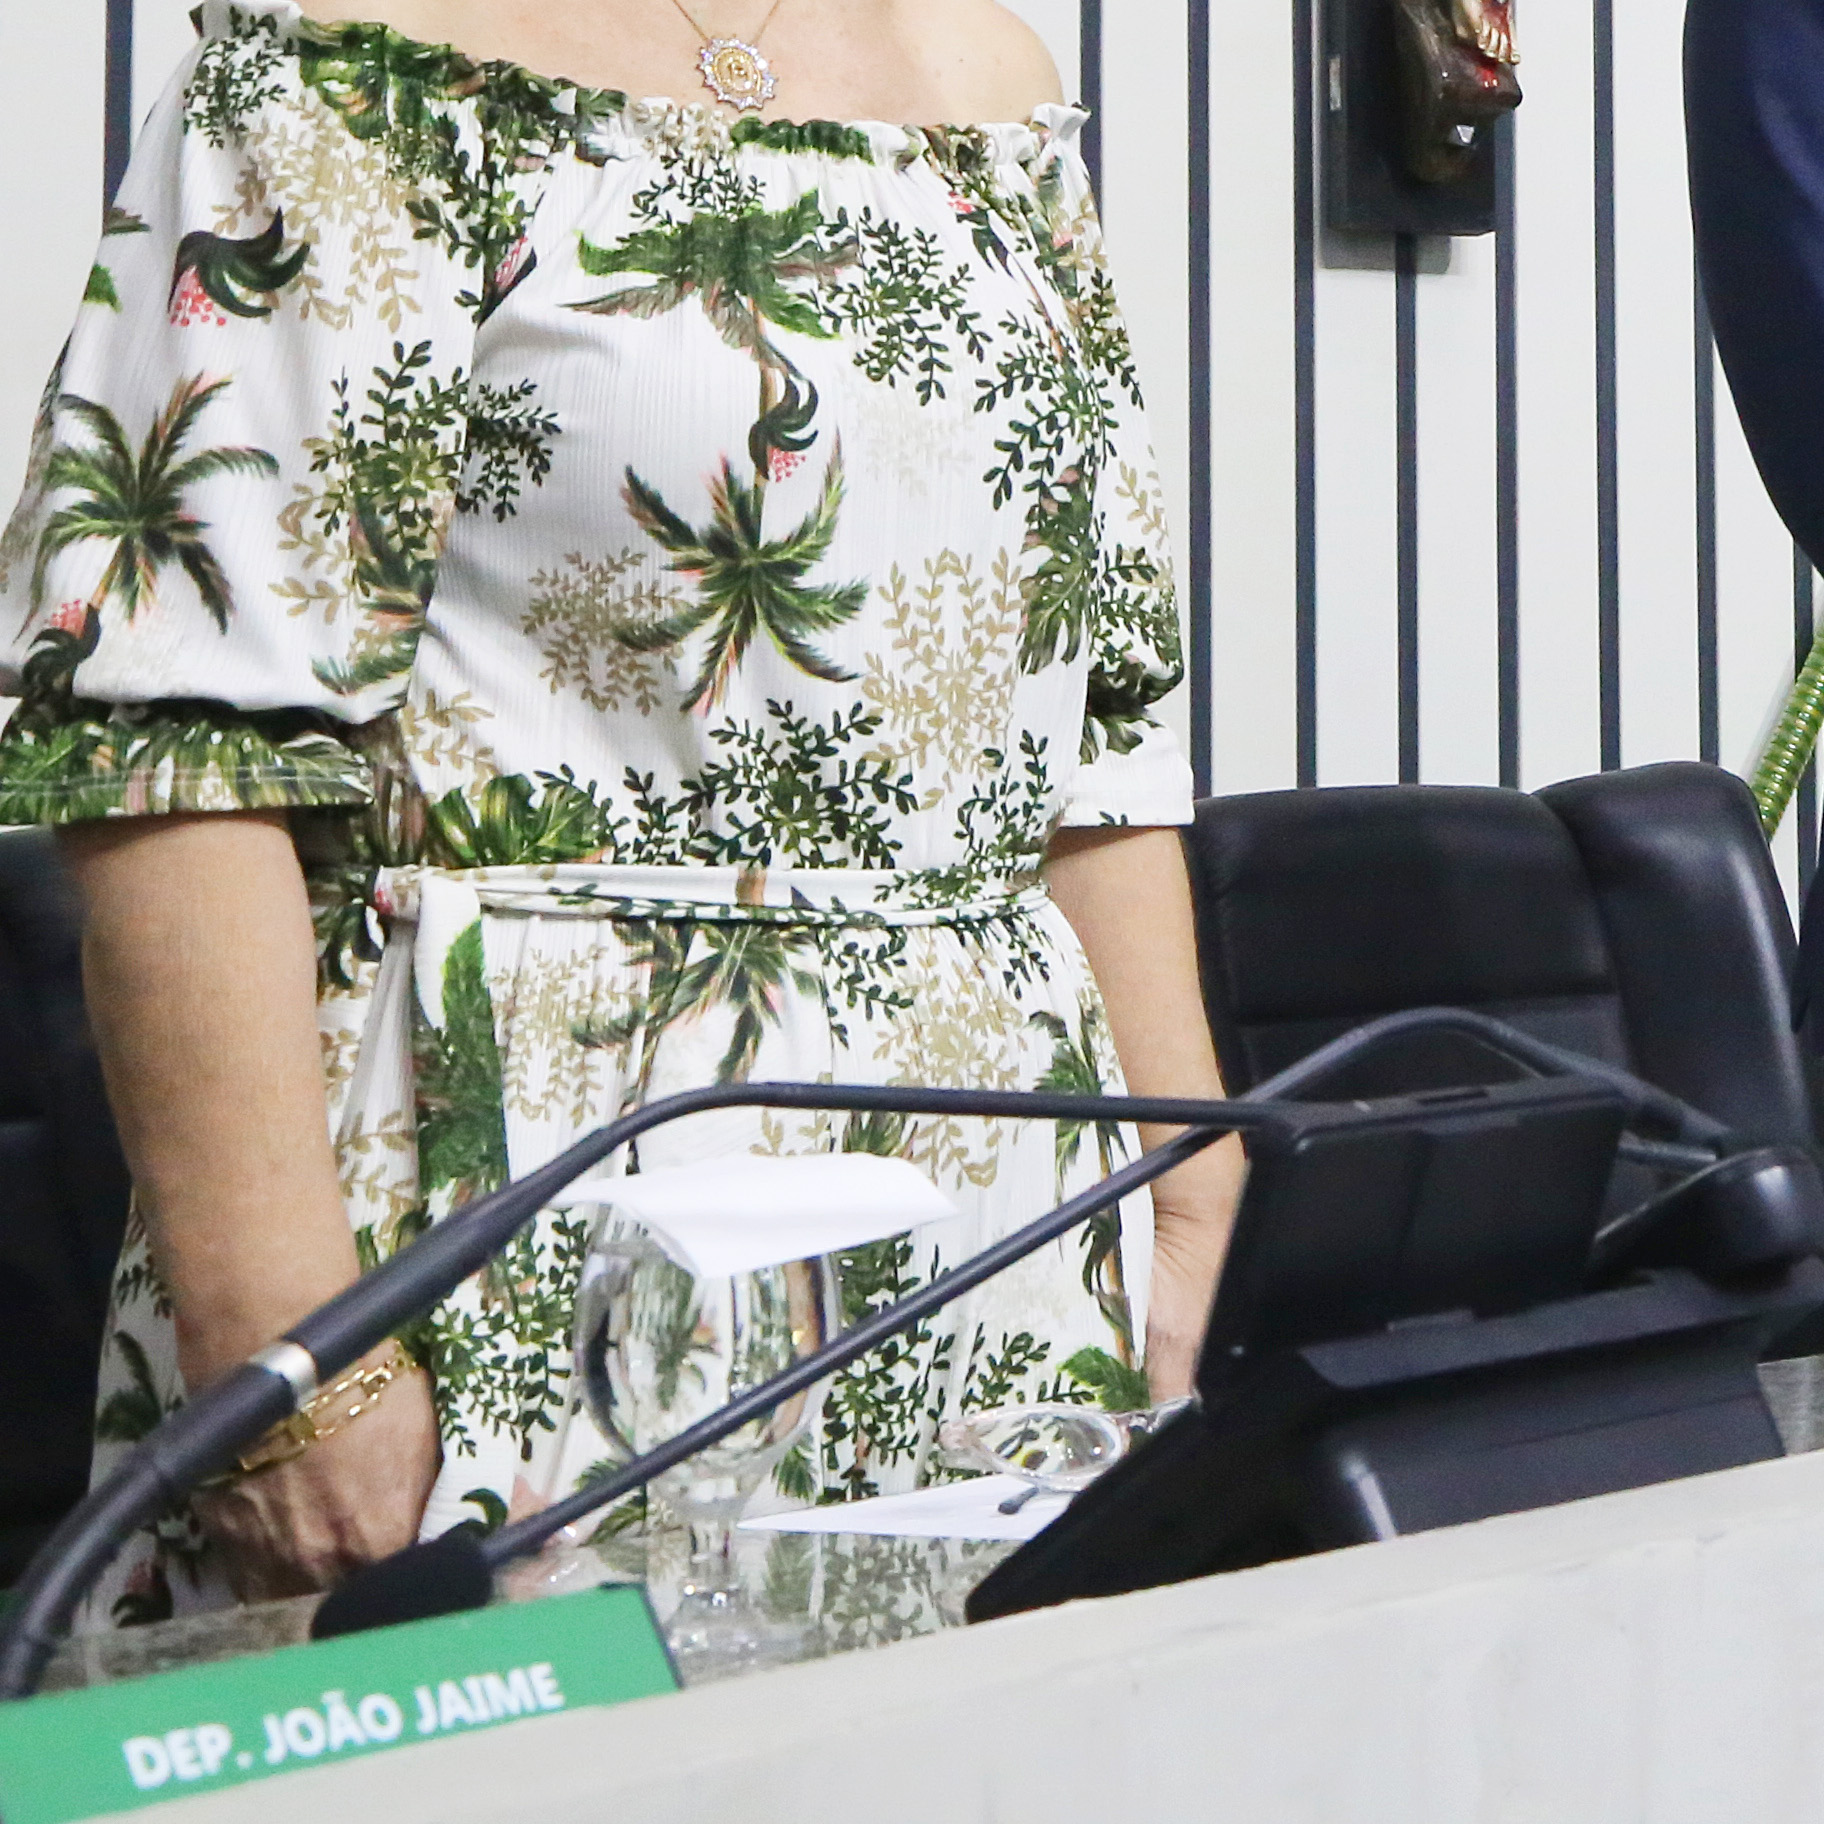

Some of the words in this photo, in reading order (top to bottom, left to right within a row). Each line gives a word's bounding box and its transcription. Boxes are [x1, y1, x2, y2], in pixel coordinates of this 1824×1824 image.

[122, 1721, 250, 1790] DEP.
[262, 1689, 402, 1766] JOÃO
[413, 1662, 564, 1734] JAIME
